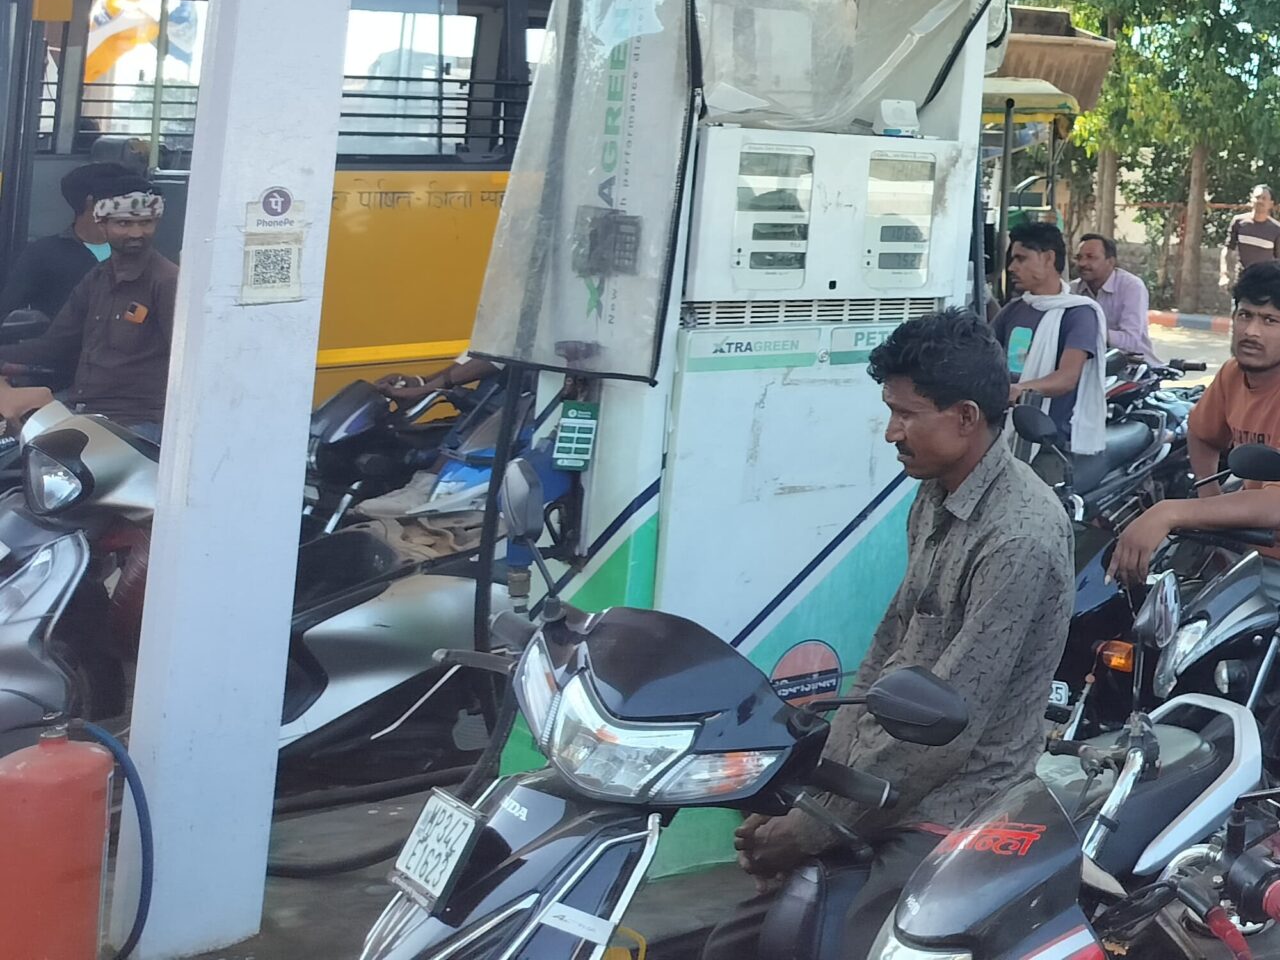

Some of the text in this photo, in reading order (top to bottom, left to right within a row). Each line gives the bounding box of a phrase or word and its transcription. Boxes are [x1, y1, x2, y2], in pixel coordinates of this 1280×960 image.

[622, 71, 640, 188] performance
[256, 218, 295, 227] PhonePe
[712, 336, 800, 354] XTRAGREEN
[854, 327, 890, 347] PET
